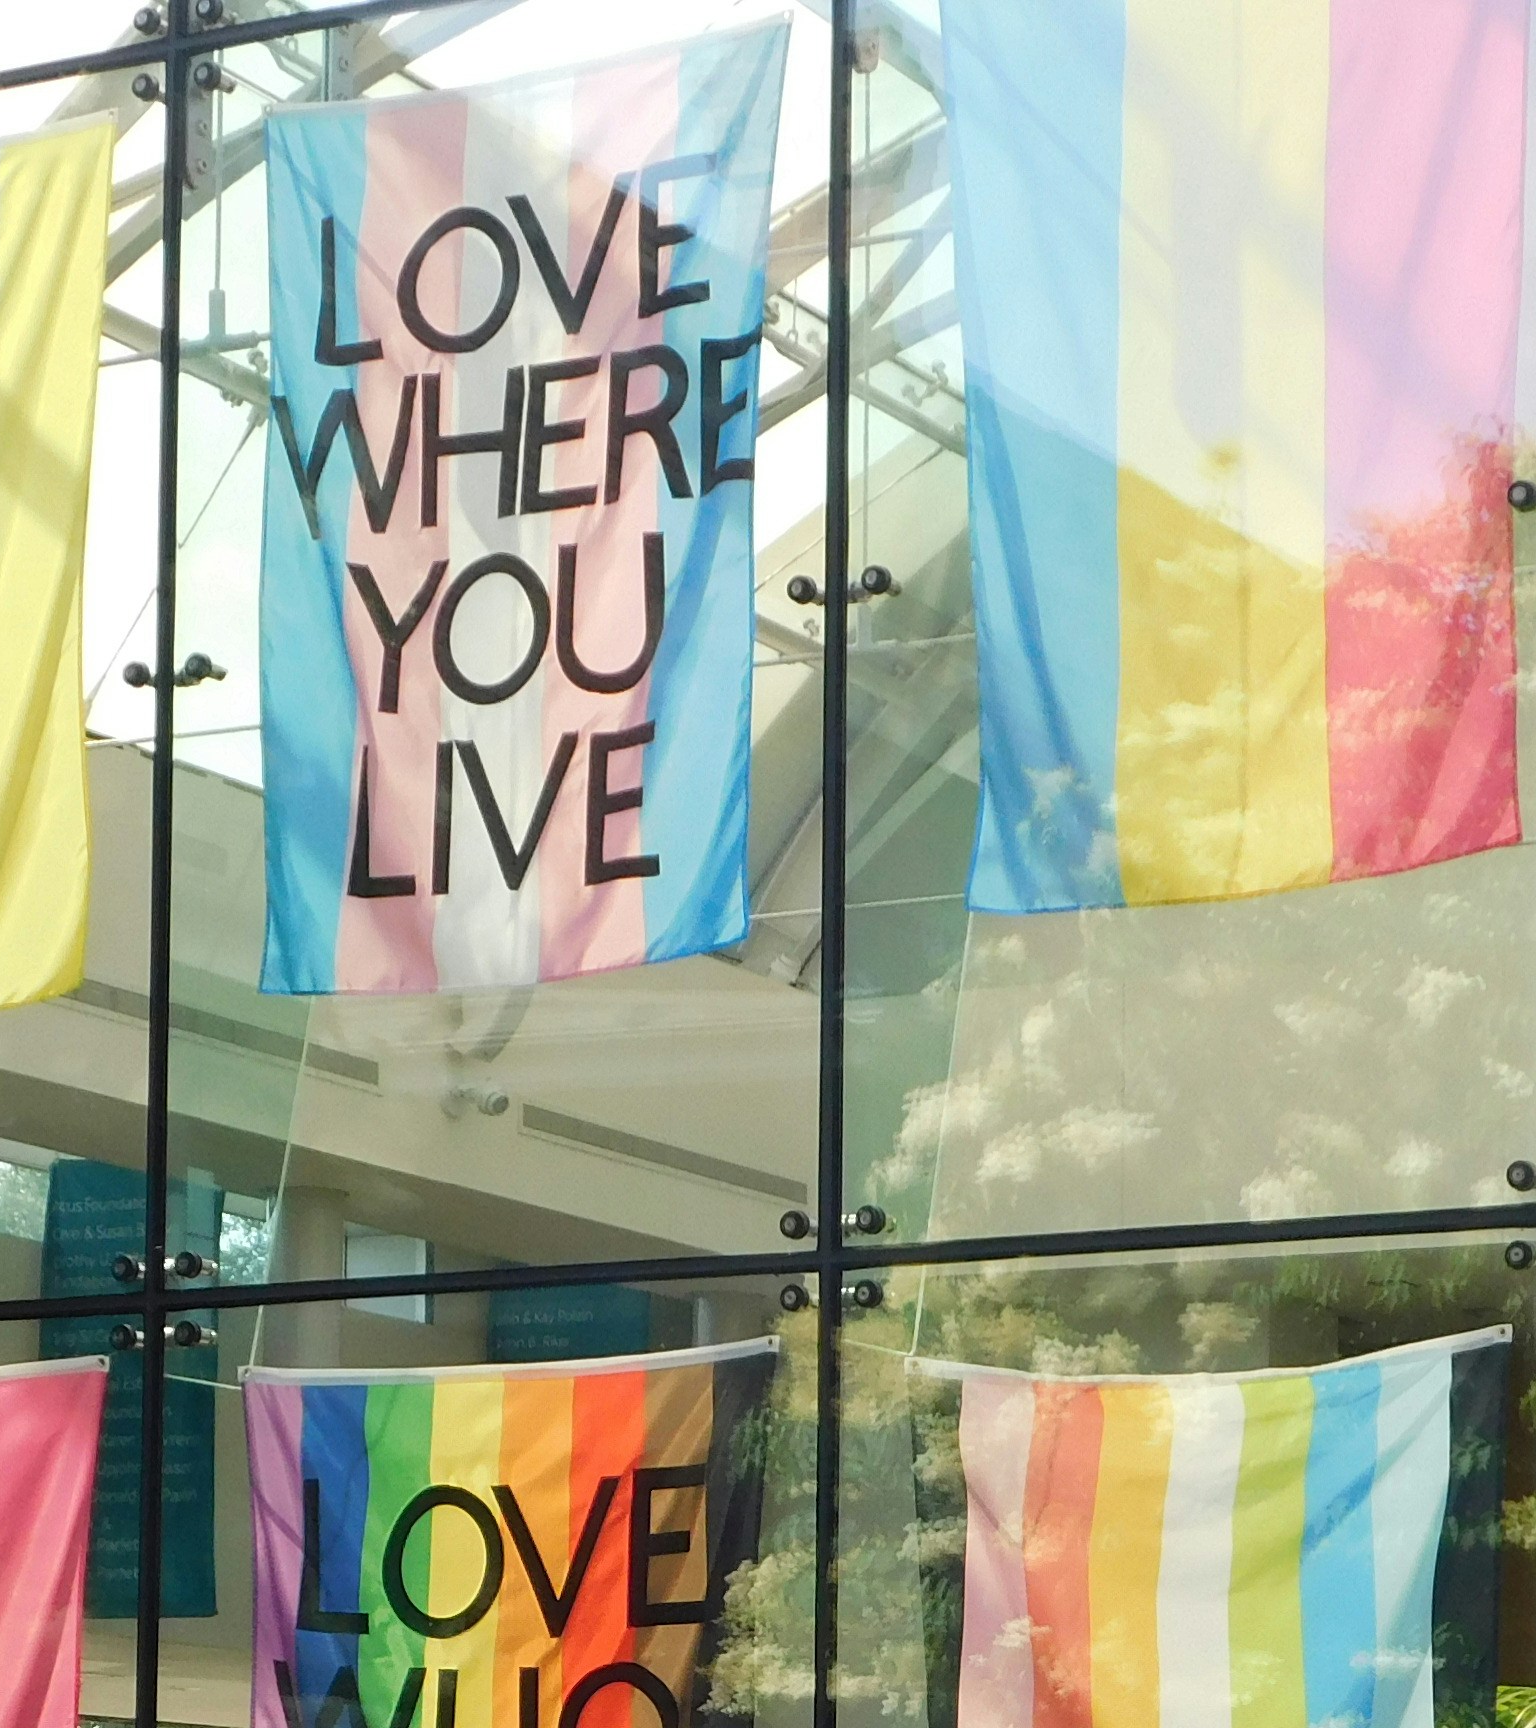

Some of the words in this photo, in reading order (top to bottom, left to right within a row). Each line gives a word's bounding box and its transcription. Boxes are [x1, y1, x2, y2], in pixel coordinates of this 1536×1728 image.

[315, 152, 718, 367] LOVE
[270, 324, 763, 541] WHERE
[345, 531, 665, 714] YOU
[346, 719, 661, 897] LIVE
[297, 1463, 710, 1639] LOVE
